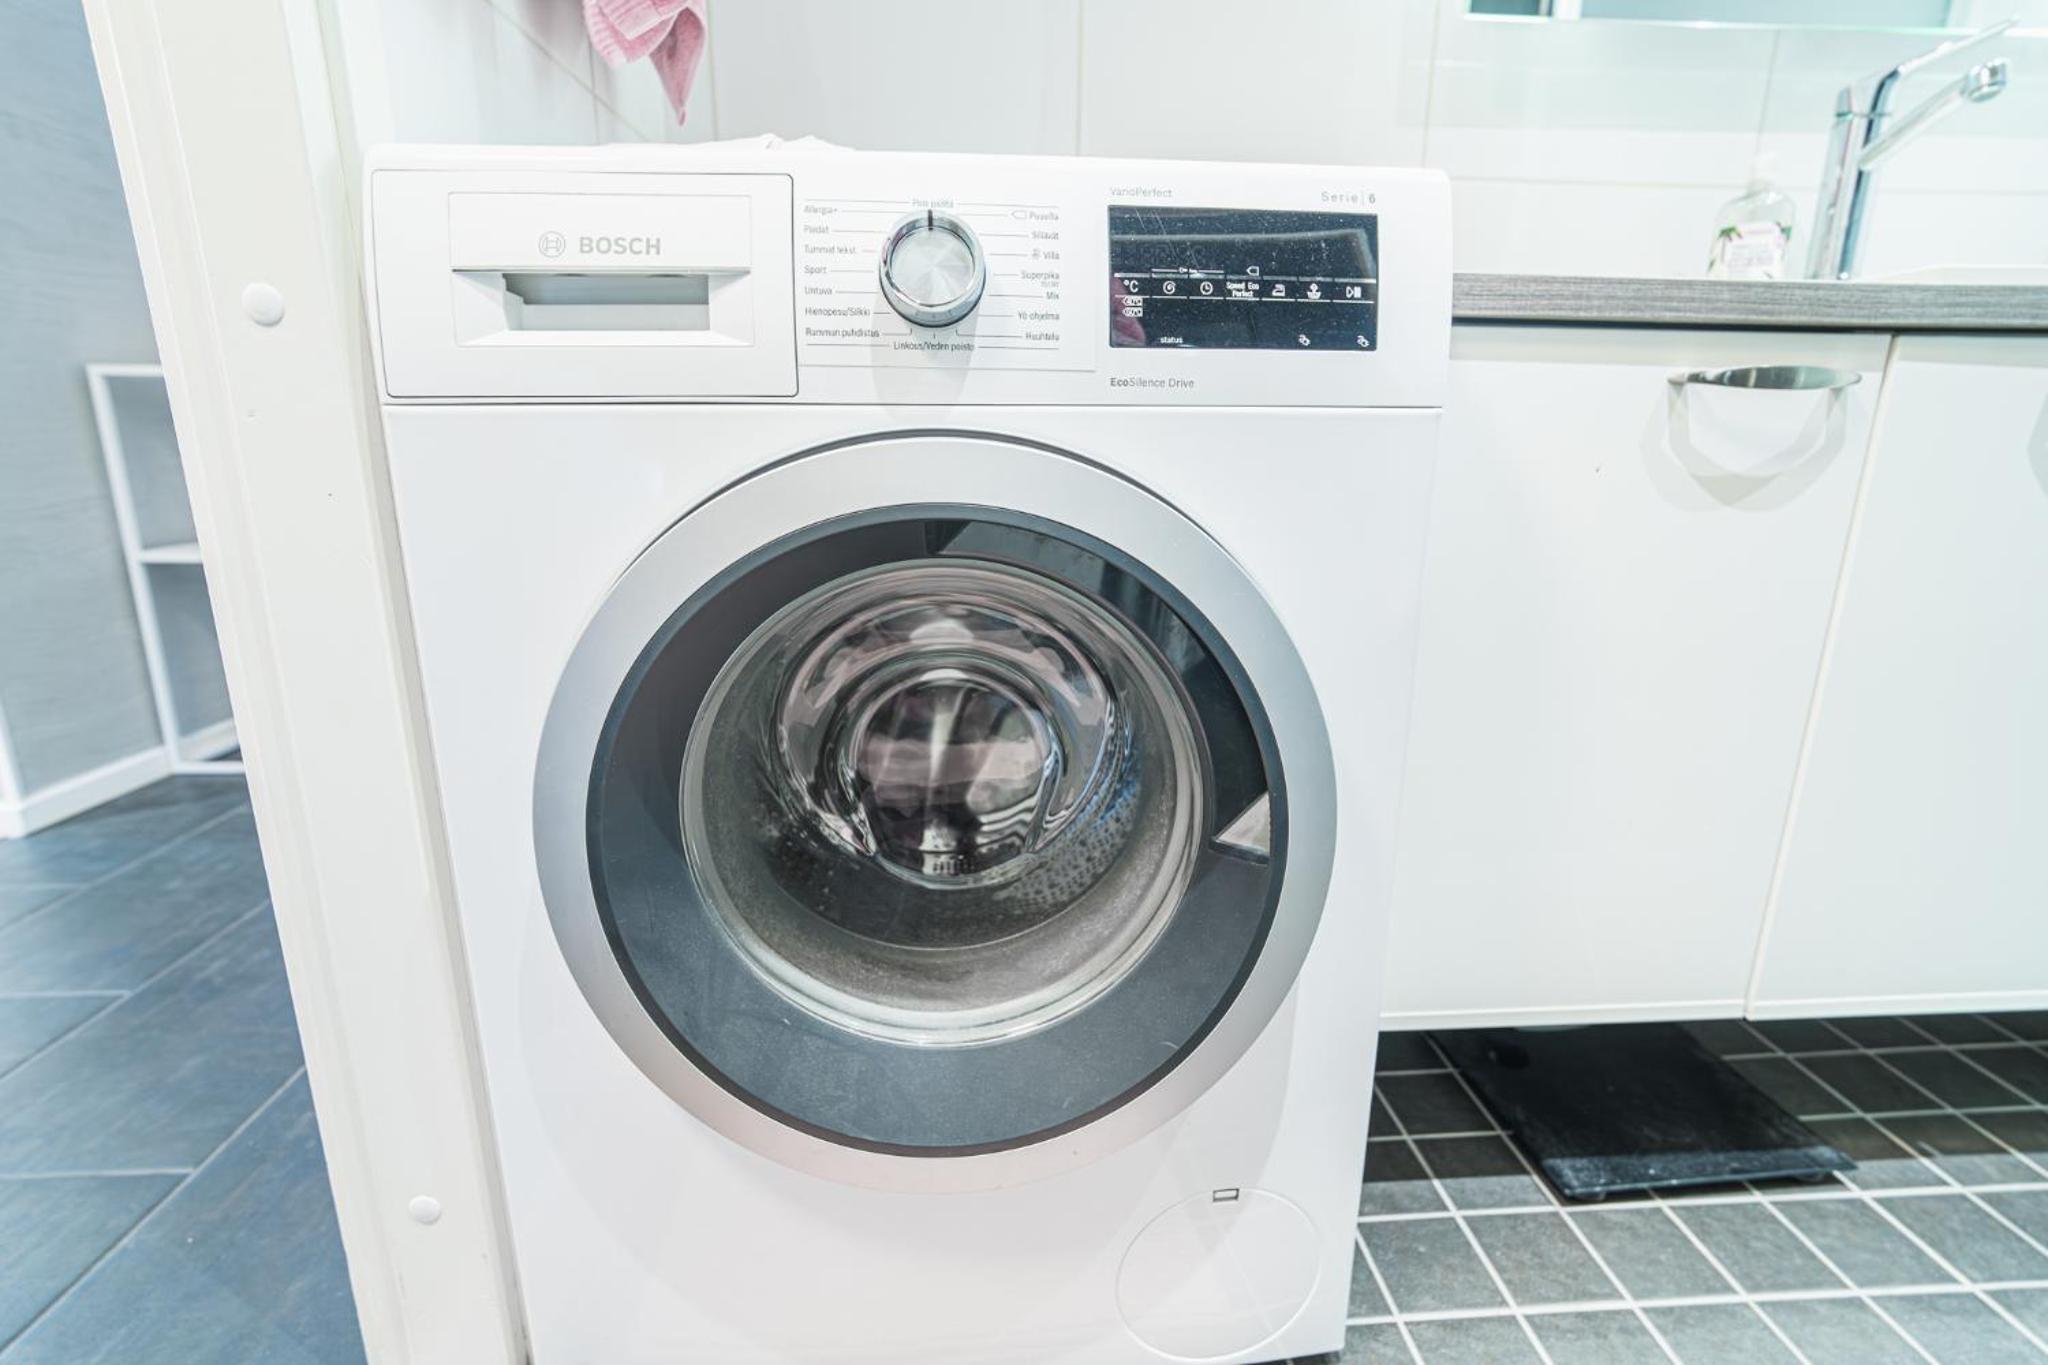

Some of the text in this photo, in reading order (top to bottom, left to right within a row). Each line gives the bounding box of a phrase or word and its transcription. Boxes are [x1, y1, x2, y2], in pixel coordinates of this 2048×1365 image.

[1110, 186, 1174, 198] VarioPerfect
[1321, 190, 1377, 205] Serie 6
[579, 236, 661, 256] BOSCH
[1042, 250, 1060, 260] Villa
[804, 264, 828, 275] Sport
[1021, 270, 1060, 280] Superpika
[804, 286, 832, 295] Untuva
[951, 342, 975, 353] poisto
[1110, 376, 1195, 389] EcoSilence Drive
